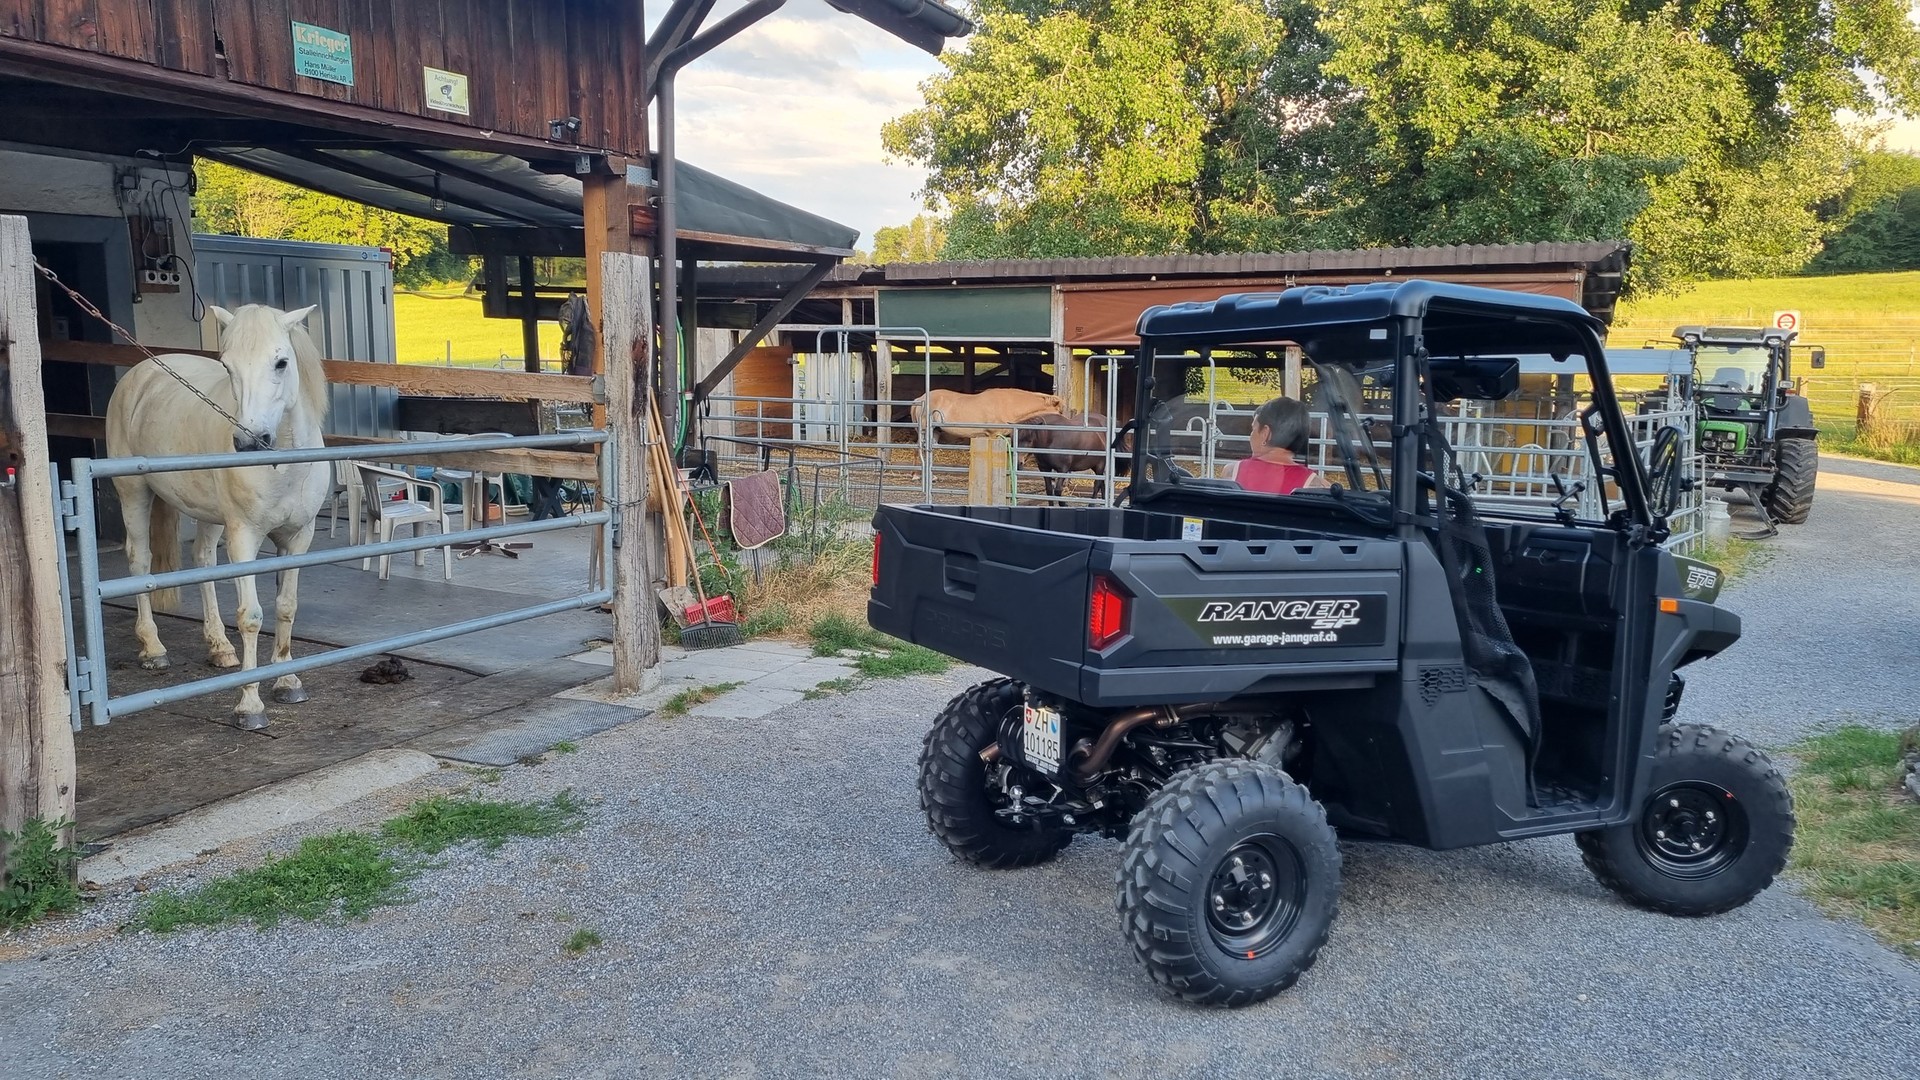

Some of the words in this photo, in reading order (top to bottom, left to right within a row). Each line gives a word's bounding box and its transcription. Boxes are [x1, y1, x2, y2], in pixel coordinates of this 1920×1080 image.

[295, 26, 348, 53] Krieger
[298, 46, 350, 65] Stalleinrichtungen
[304, 60, 320, 70] Hans
[1197, 600, 1361, 622] RANGER
[1311, 618, 1361, 629] SP
[1213, 631, 1337, 647] www.garage-janngraf.ch
[1034, 708, 1049, 734] ZH
[1025, 730, 1059, 761] 101185
